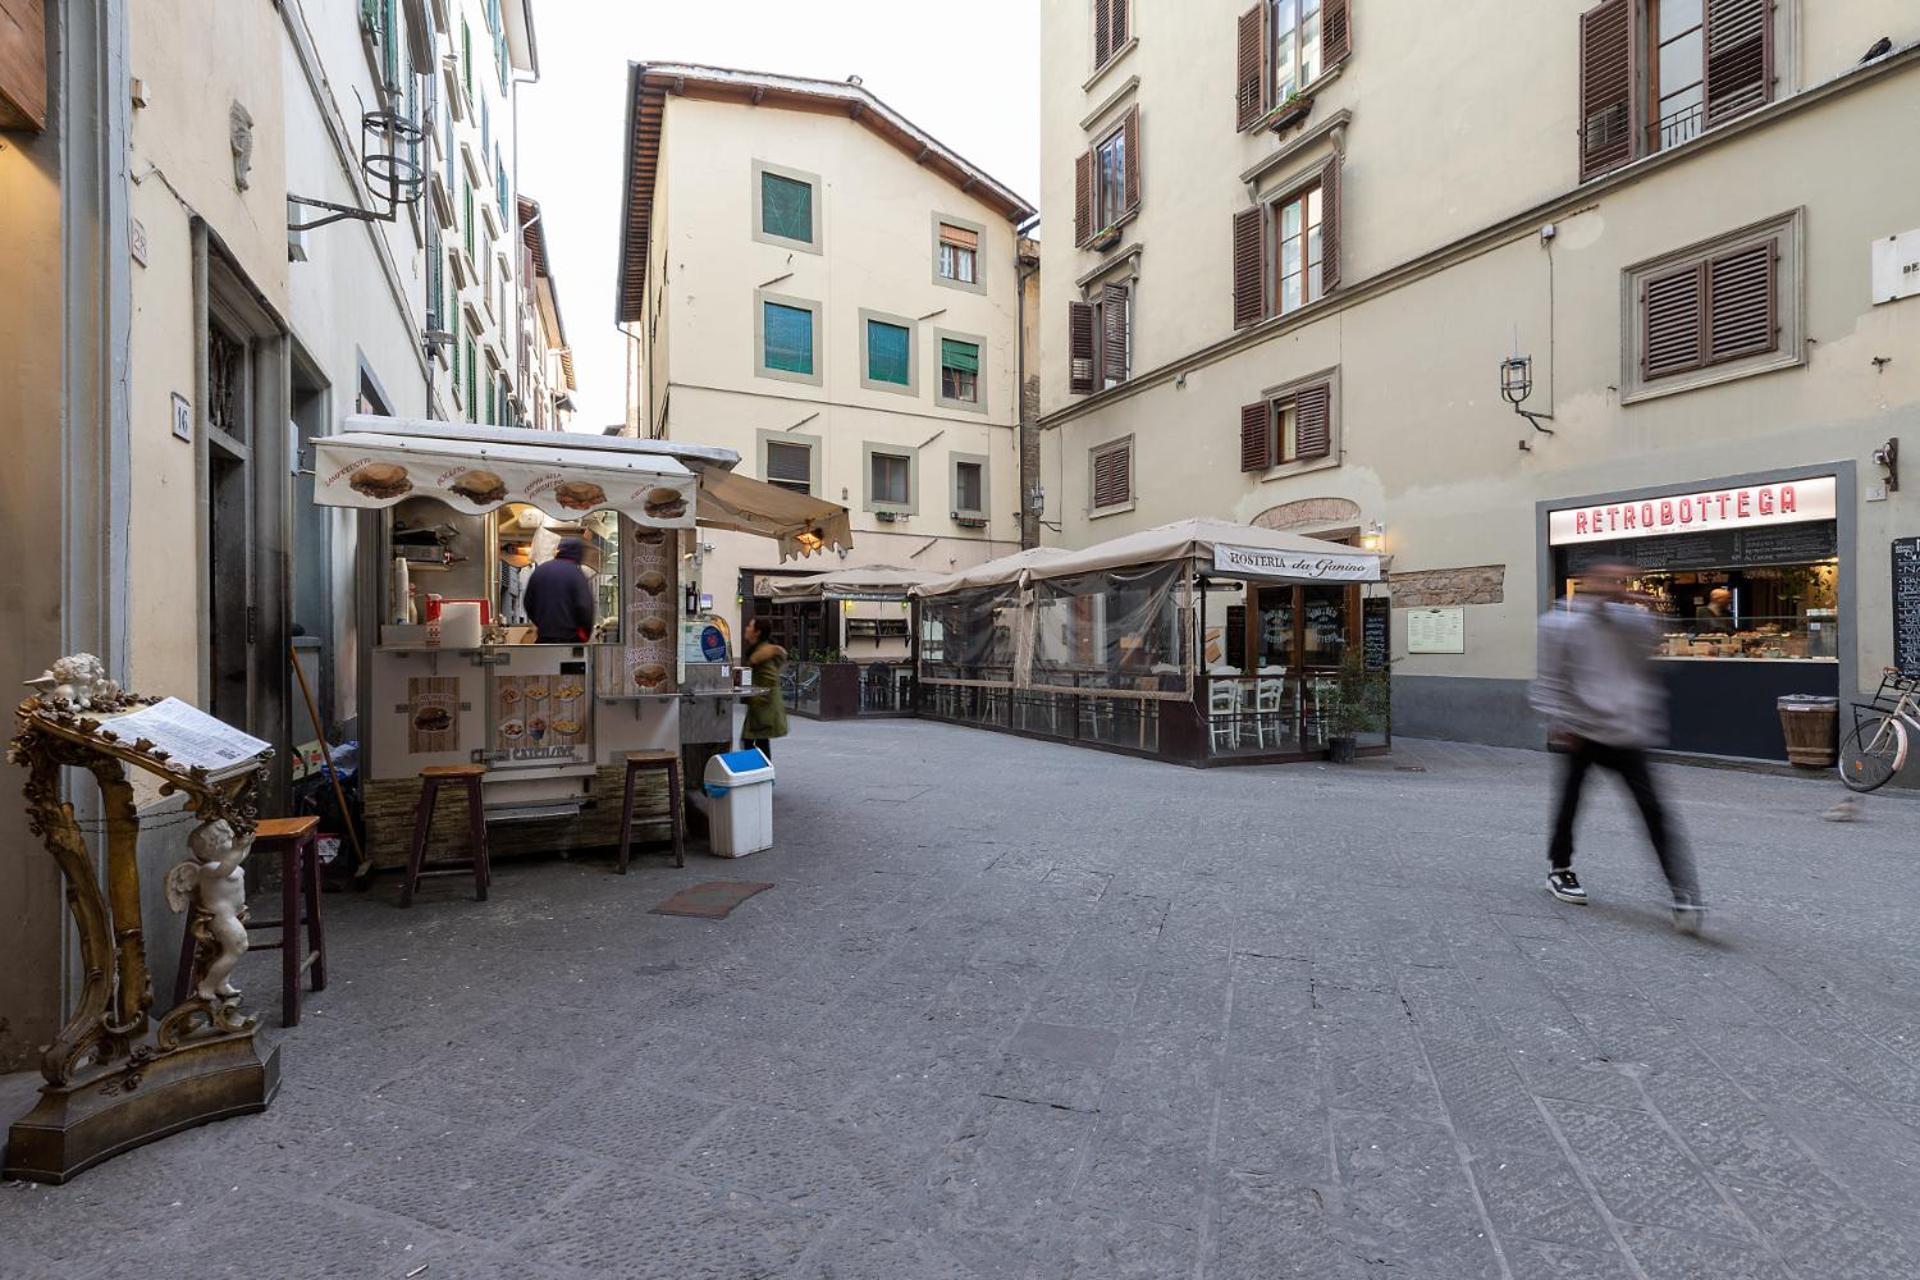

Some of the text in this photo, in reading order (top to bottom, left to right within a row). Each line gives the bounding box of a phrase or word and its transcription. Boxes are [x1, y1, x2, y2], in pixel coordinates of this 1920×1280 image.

[177, 406, 188, 433] 16
[1575, 485, 1798, 535] RETROBOTTEGA
[1229, 552, 1367, 577] HOSTERIA da Ganino
